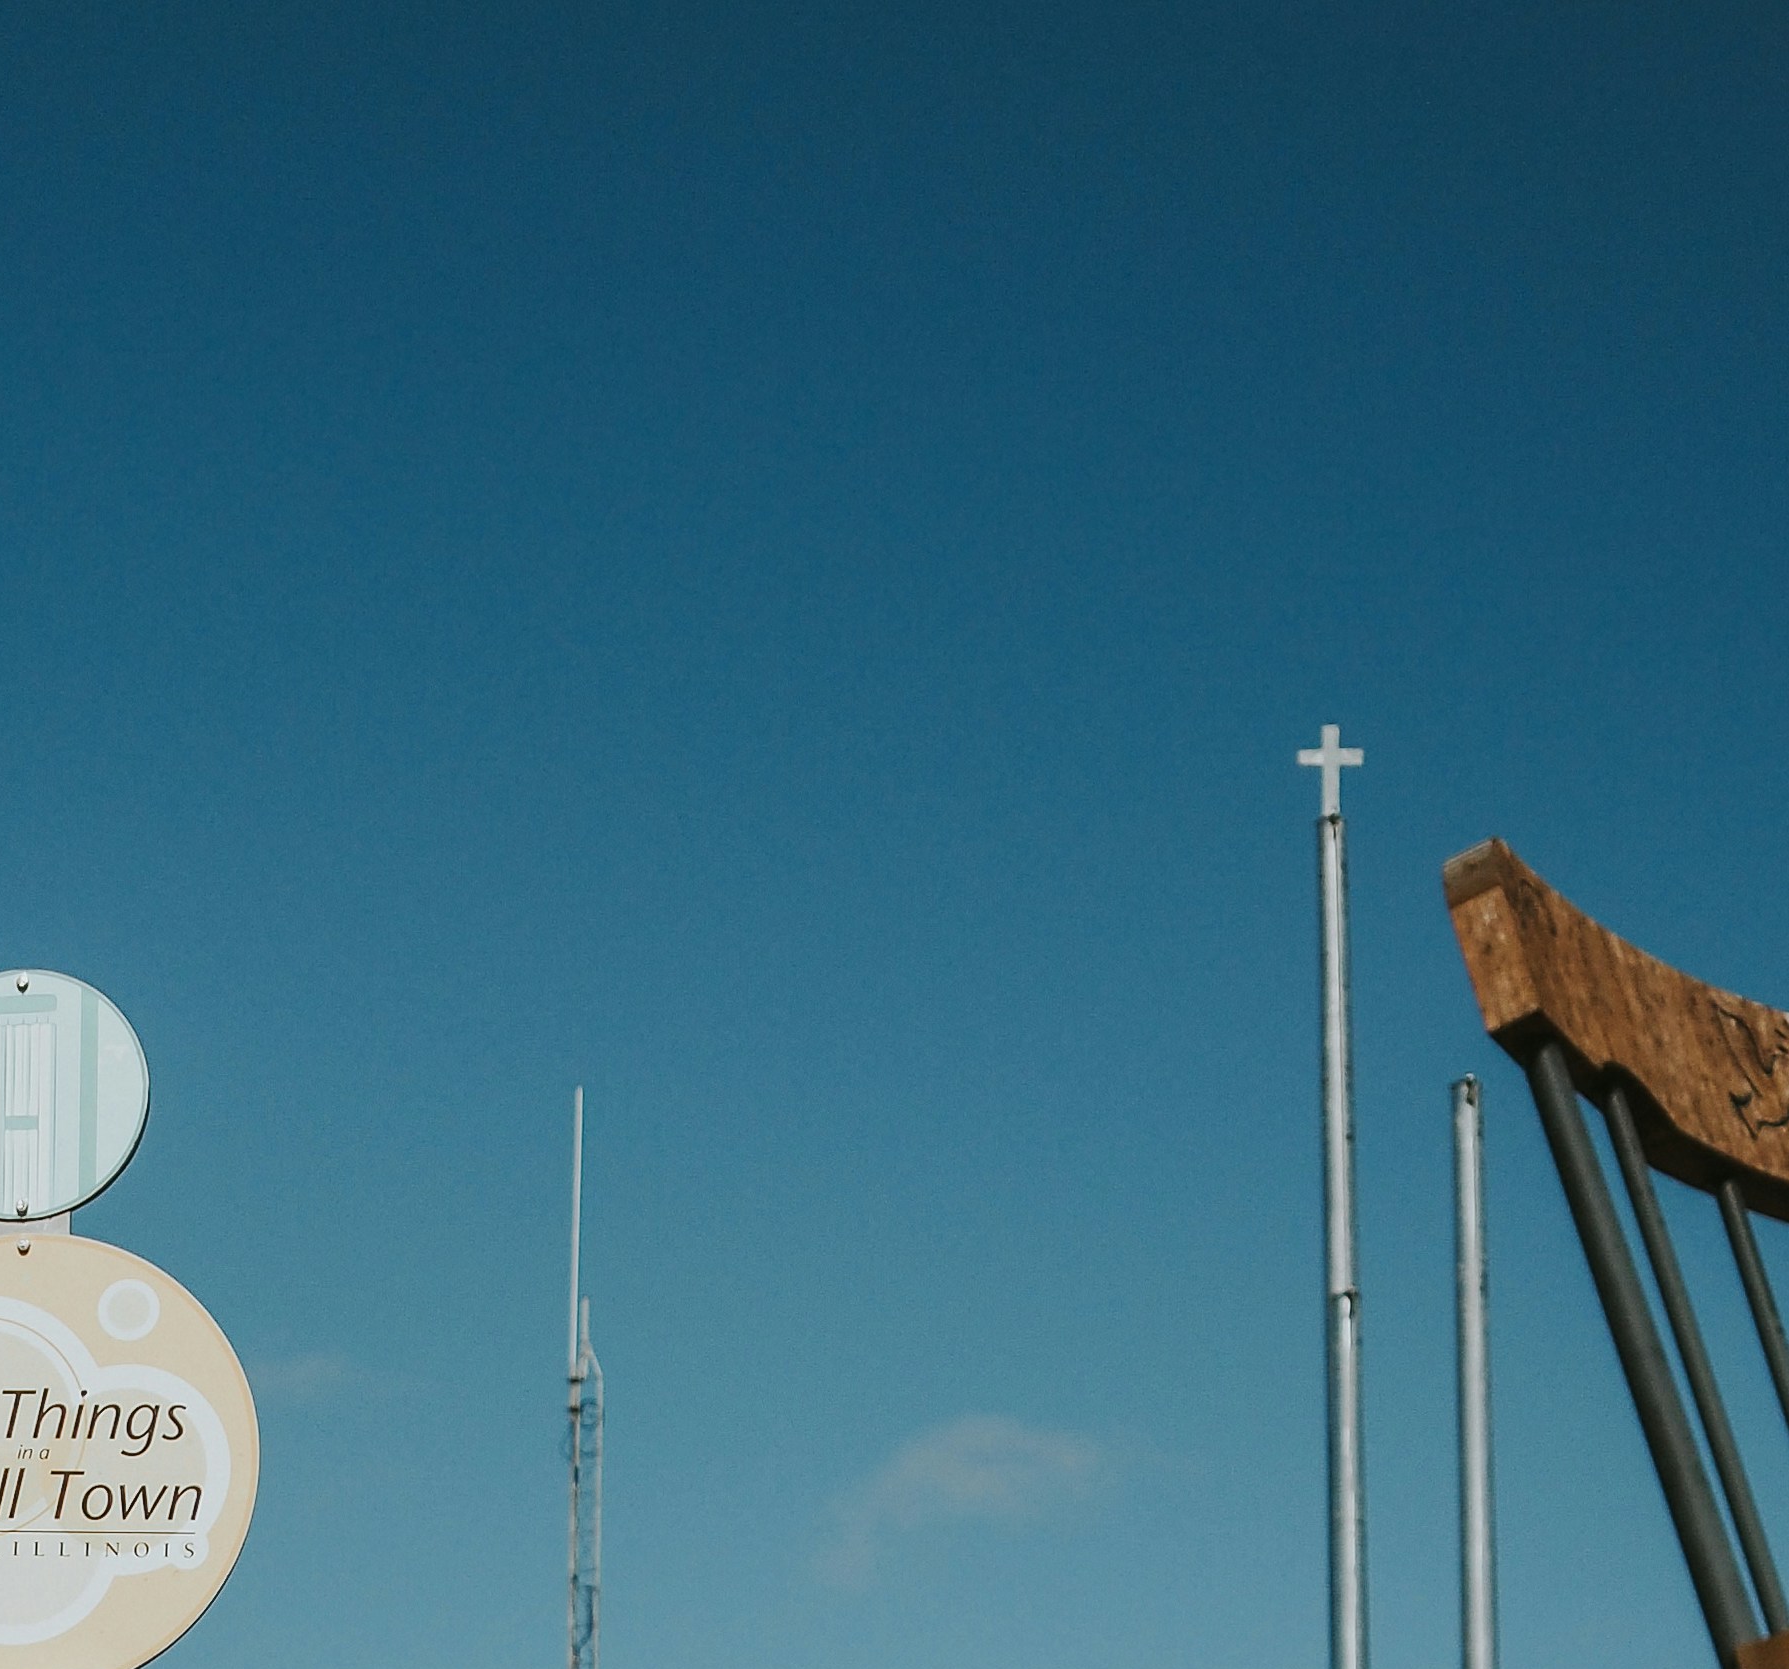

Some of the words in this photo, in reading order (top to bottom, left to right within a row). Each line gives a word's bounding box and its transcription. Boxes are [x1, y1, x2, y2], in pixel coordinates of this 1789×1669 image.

[2, 1388, 187, 1457] Things
[17, 1445, 33, 1460] in
[39, 1449, 50, 1460] a
[50, 1470, 203, 1521] Town
[12, 1541, 196, 1558] ILLINOIS
